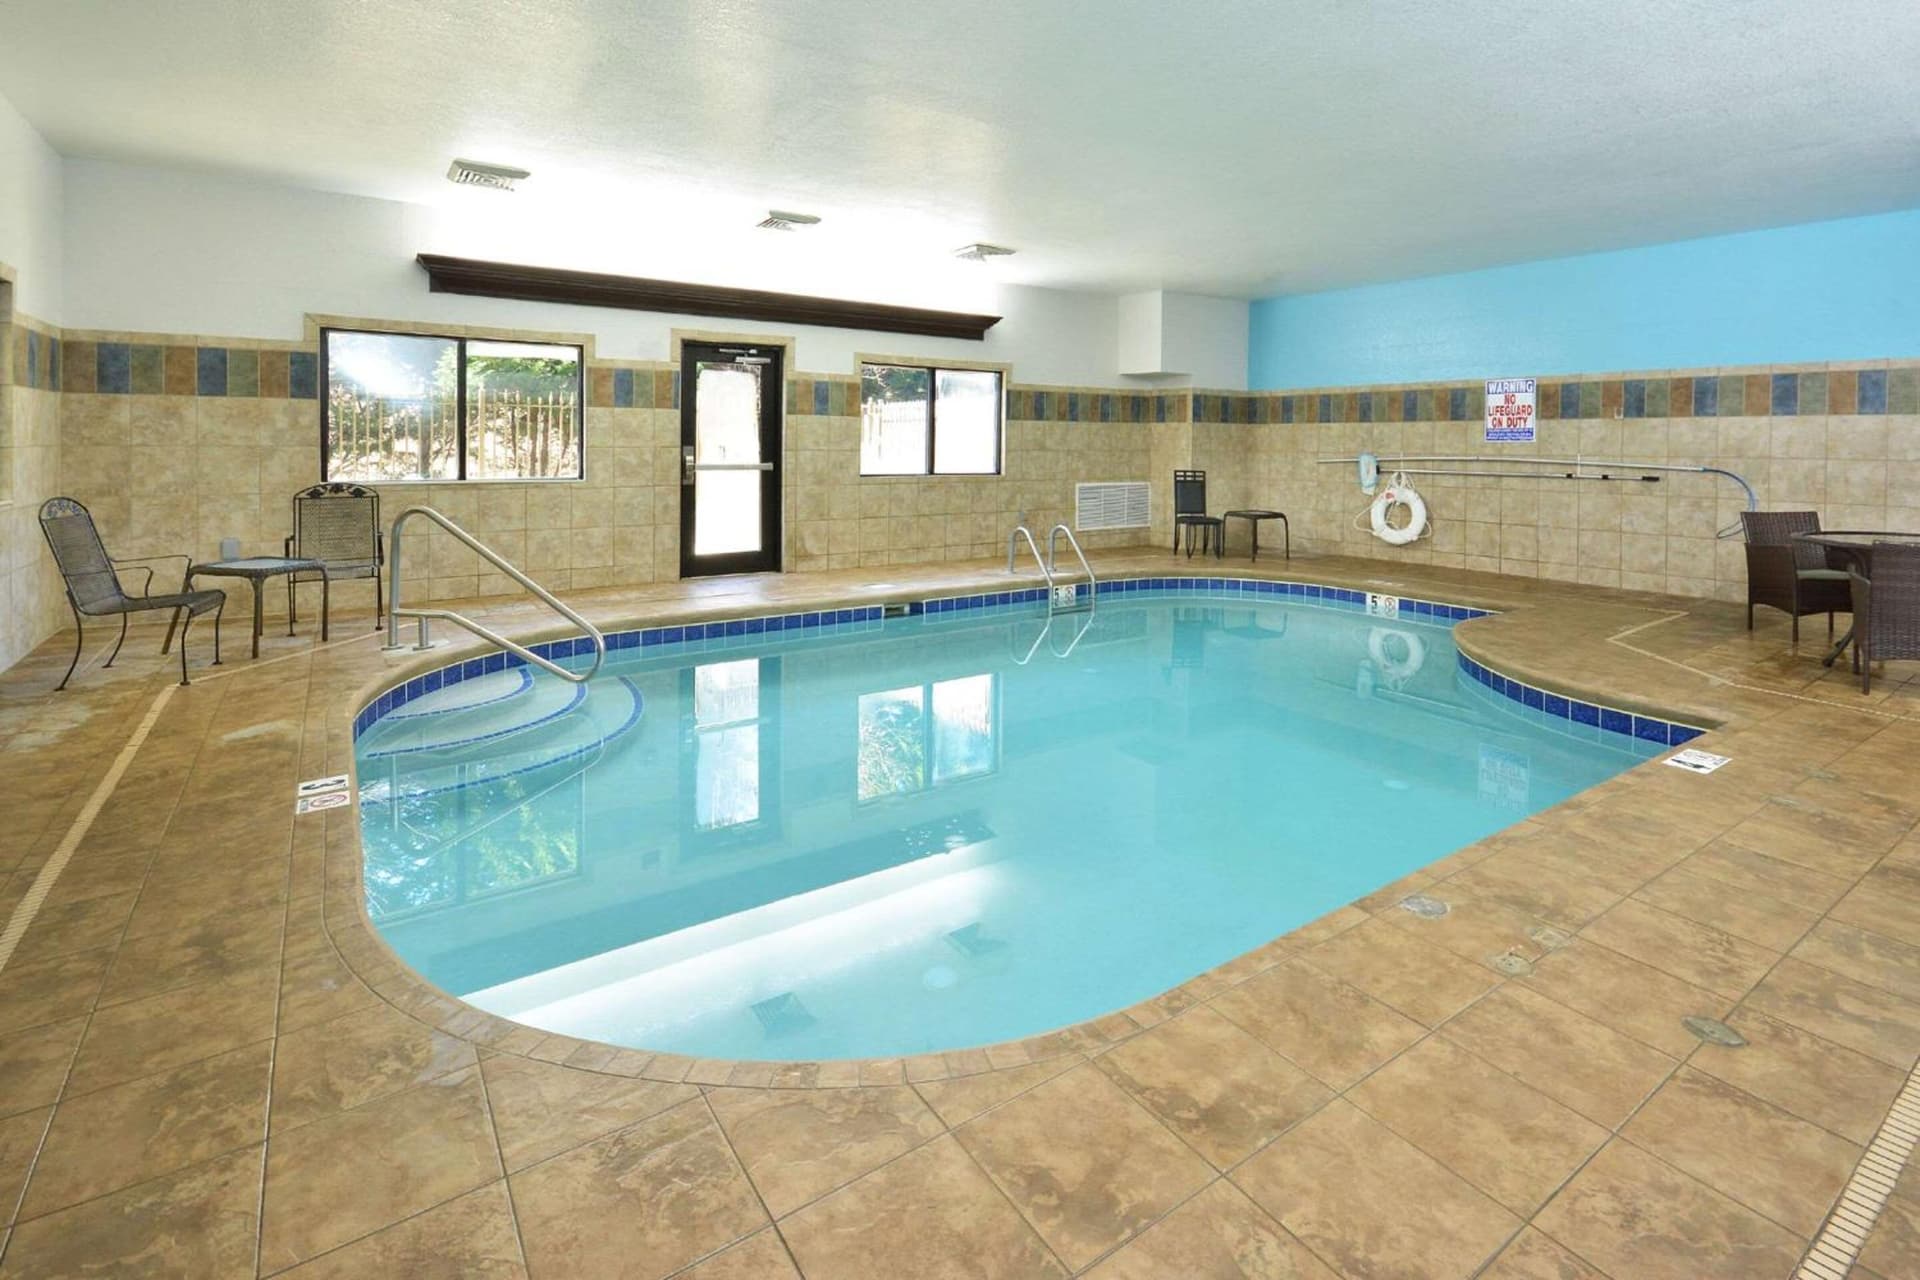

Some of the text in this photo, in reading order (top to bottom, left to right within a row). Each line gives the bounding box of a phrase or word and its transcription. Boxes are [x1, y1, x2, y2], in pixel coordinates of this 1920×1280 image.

[1488, 381, 1533, 394] WARNING
[1504, 394, 1516, 405] NO
[1488, 404, 1533, 416] LIFEGUARD
[1491, 416, 1528, 428] ON DUTY
